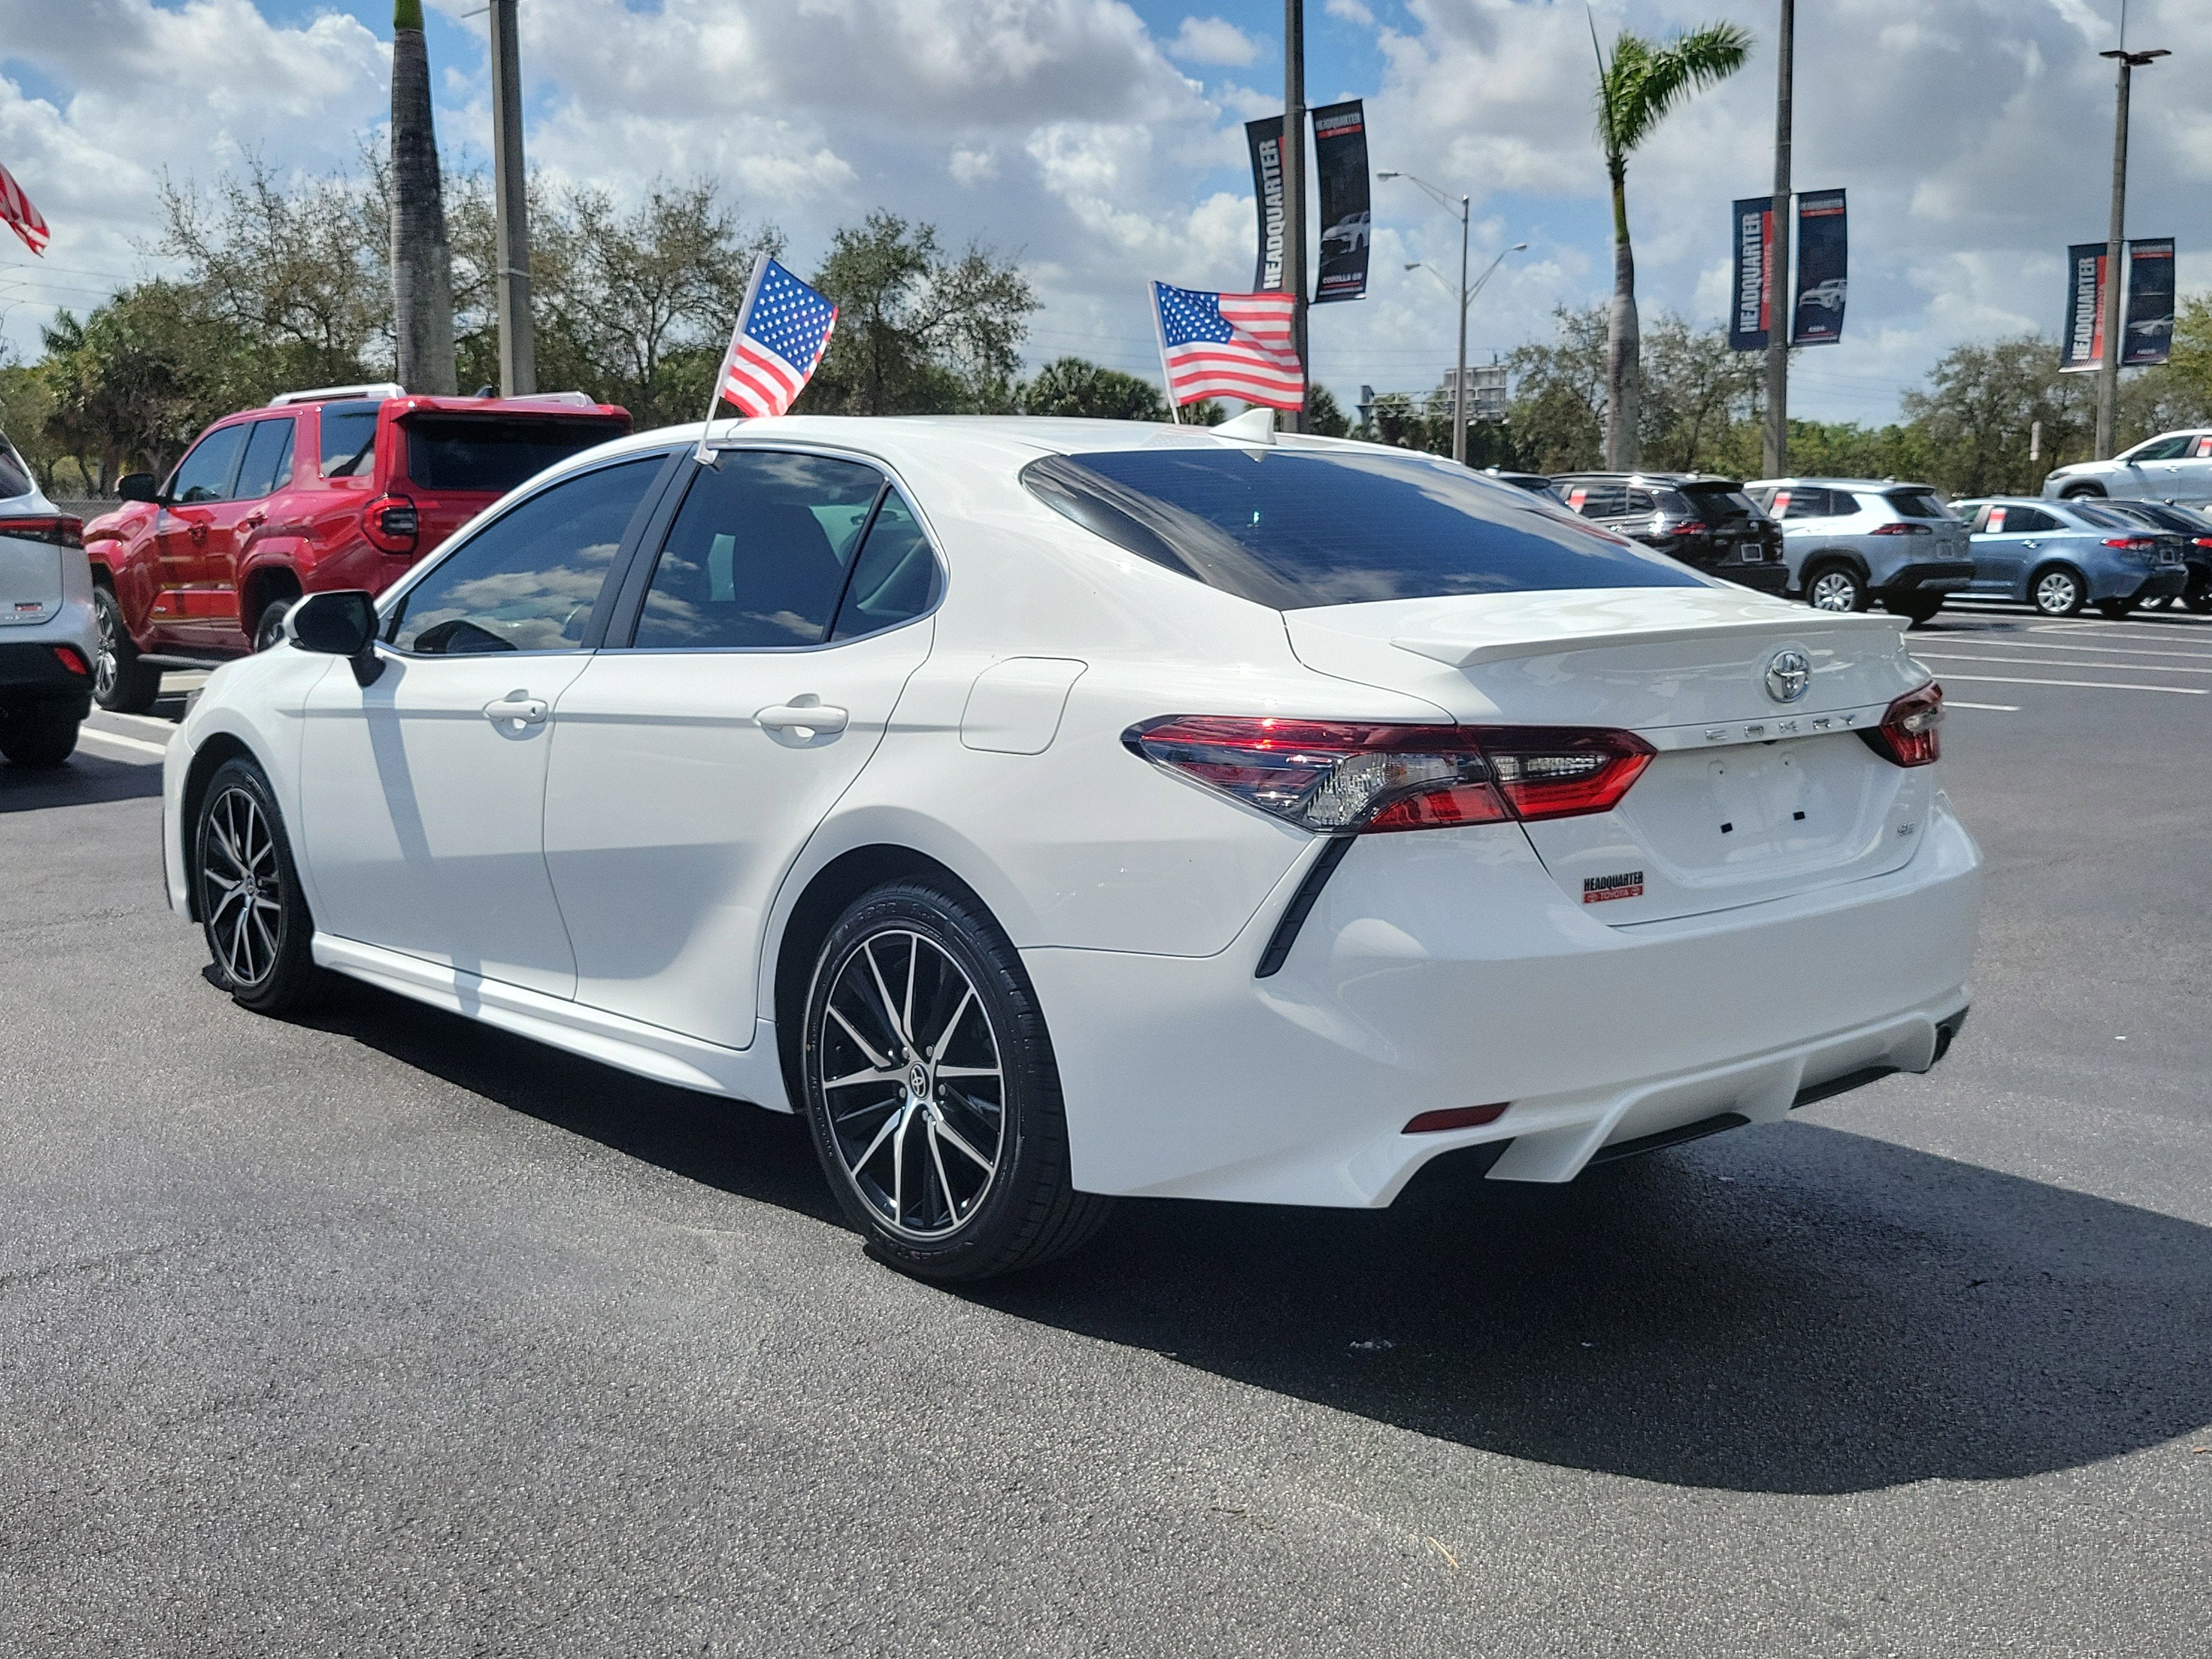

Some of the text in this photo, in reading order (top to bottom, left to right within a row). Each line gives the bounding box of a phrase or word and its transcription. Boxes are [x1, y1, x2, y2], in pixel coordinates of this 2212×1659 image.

[1259, 139, 1285, 289] HEADQUARTER
[1740, 212, 1762, 332] HEADQUARTER
[2071, 257, 2095, 360] HEADQUARTER
[1706, 714, 1856, 741] CAMRY
[1583, 871, 1643, 891] HEADQUARTER
[1600, 888, 1628, 900] TOYOTA
